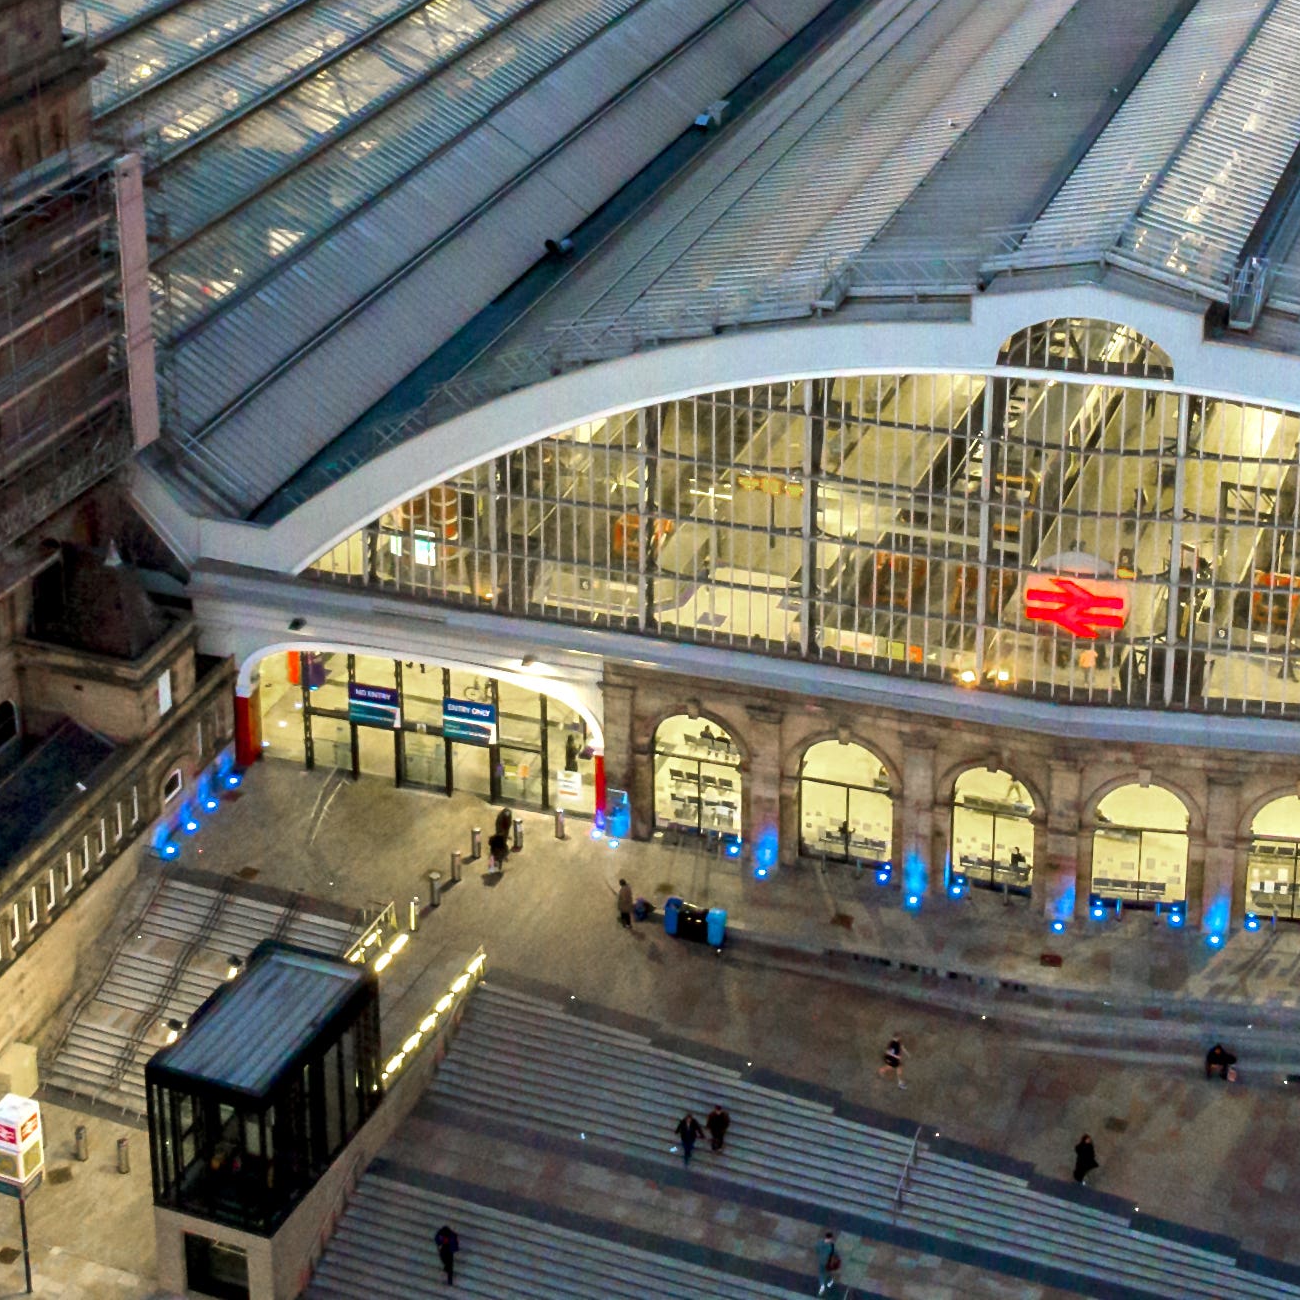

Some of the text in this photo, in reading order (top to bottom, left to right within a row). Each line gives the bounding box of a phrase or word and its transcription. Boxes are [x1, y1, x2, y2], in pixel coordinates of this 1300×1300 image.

[355, 688, 392, 700] NO ENTRY
[447, 703, 491, 717] ENTRY ONLY
